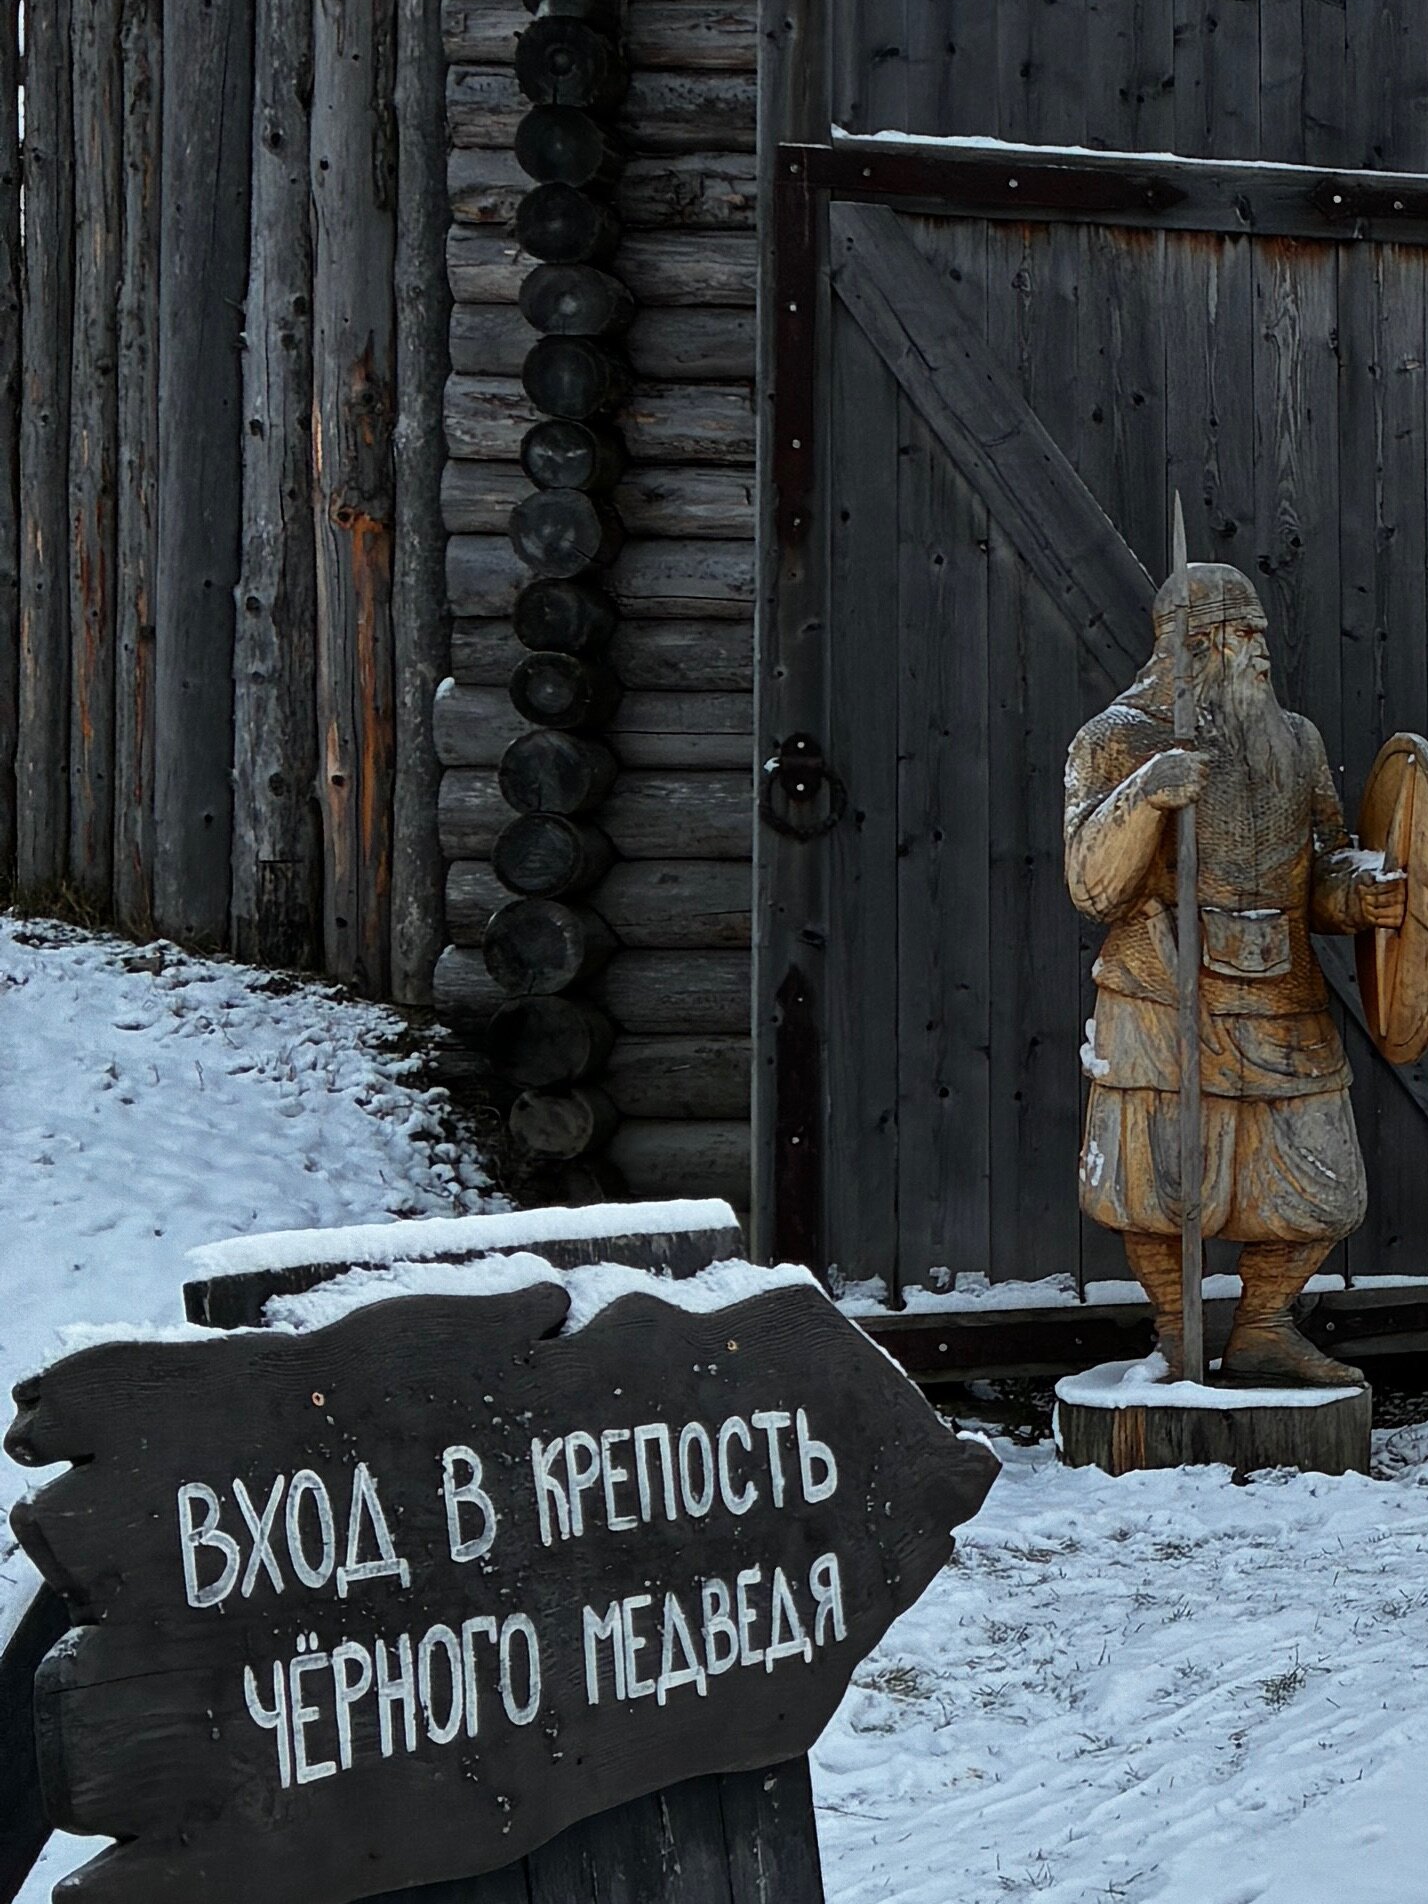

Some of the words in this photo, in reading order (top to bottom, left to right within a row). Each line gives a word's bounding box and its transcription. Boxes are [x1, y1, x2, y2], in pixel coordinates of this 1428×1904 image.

[176, 1461, 411, 1609] ВХОД
[441, 1444, 502, 1563] В
[530, 1407, 838, 1547] КРЕПОСТЬ
[243, 1612, 542, 1789] ЧЁРНОГО
[582, 1552, 848, 1706] МЕДВЕДЯ
